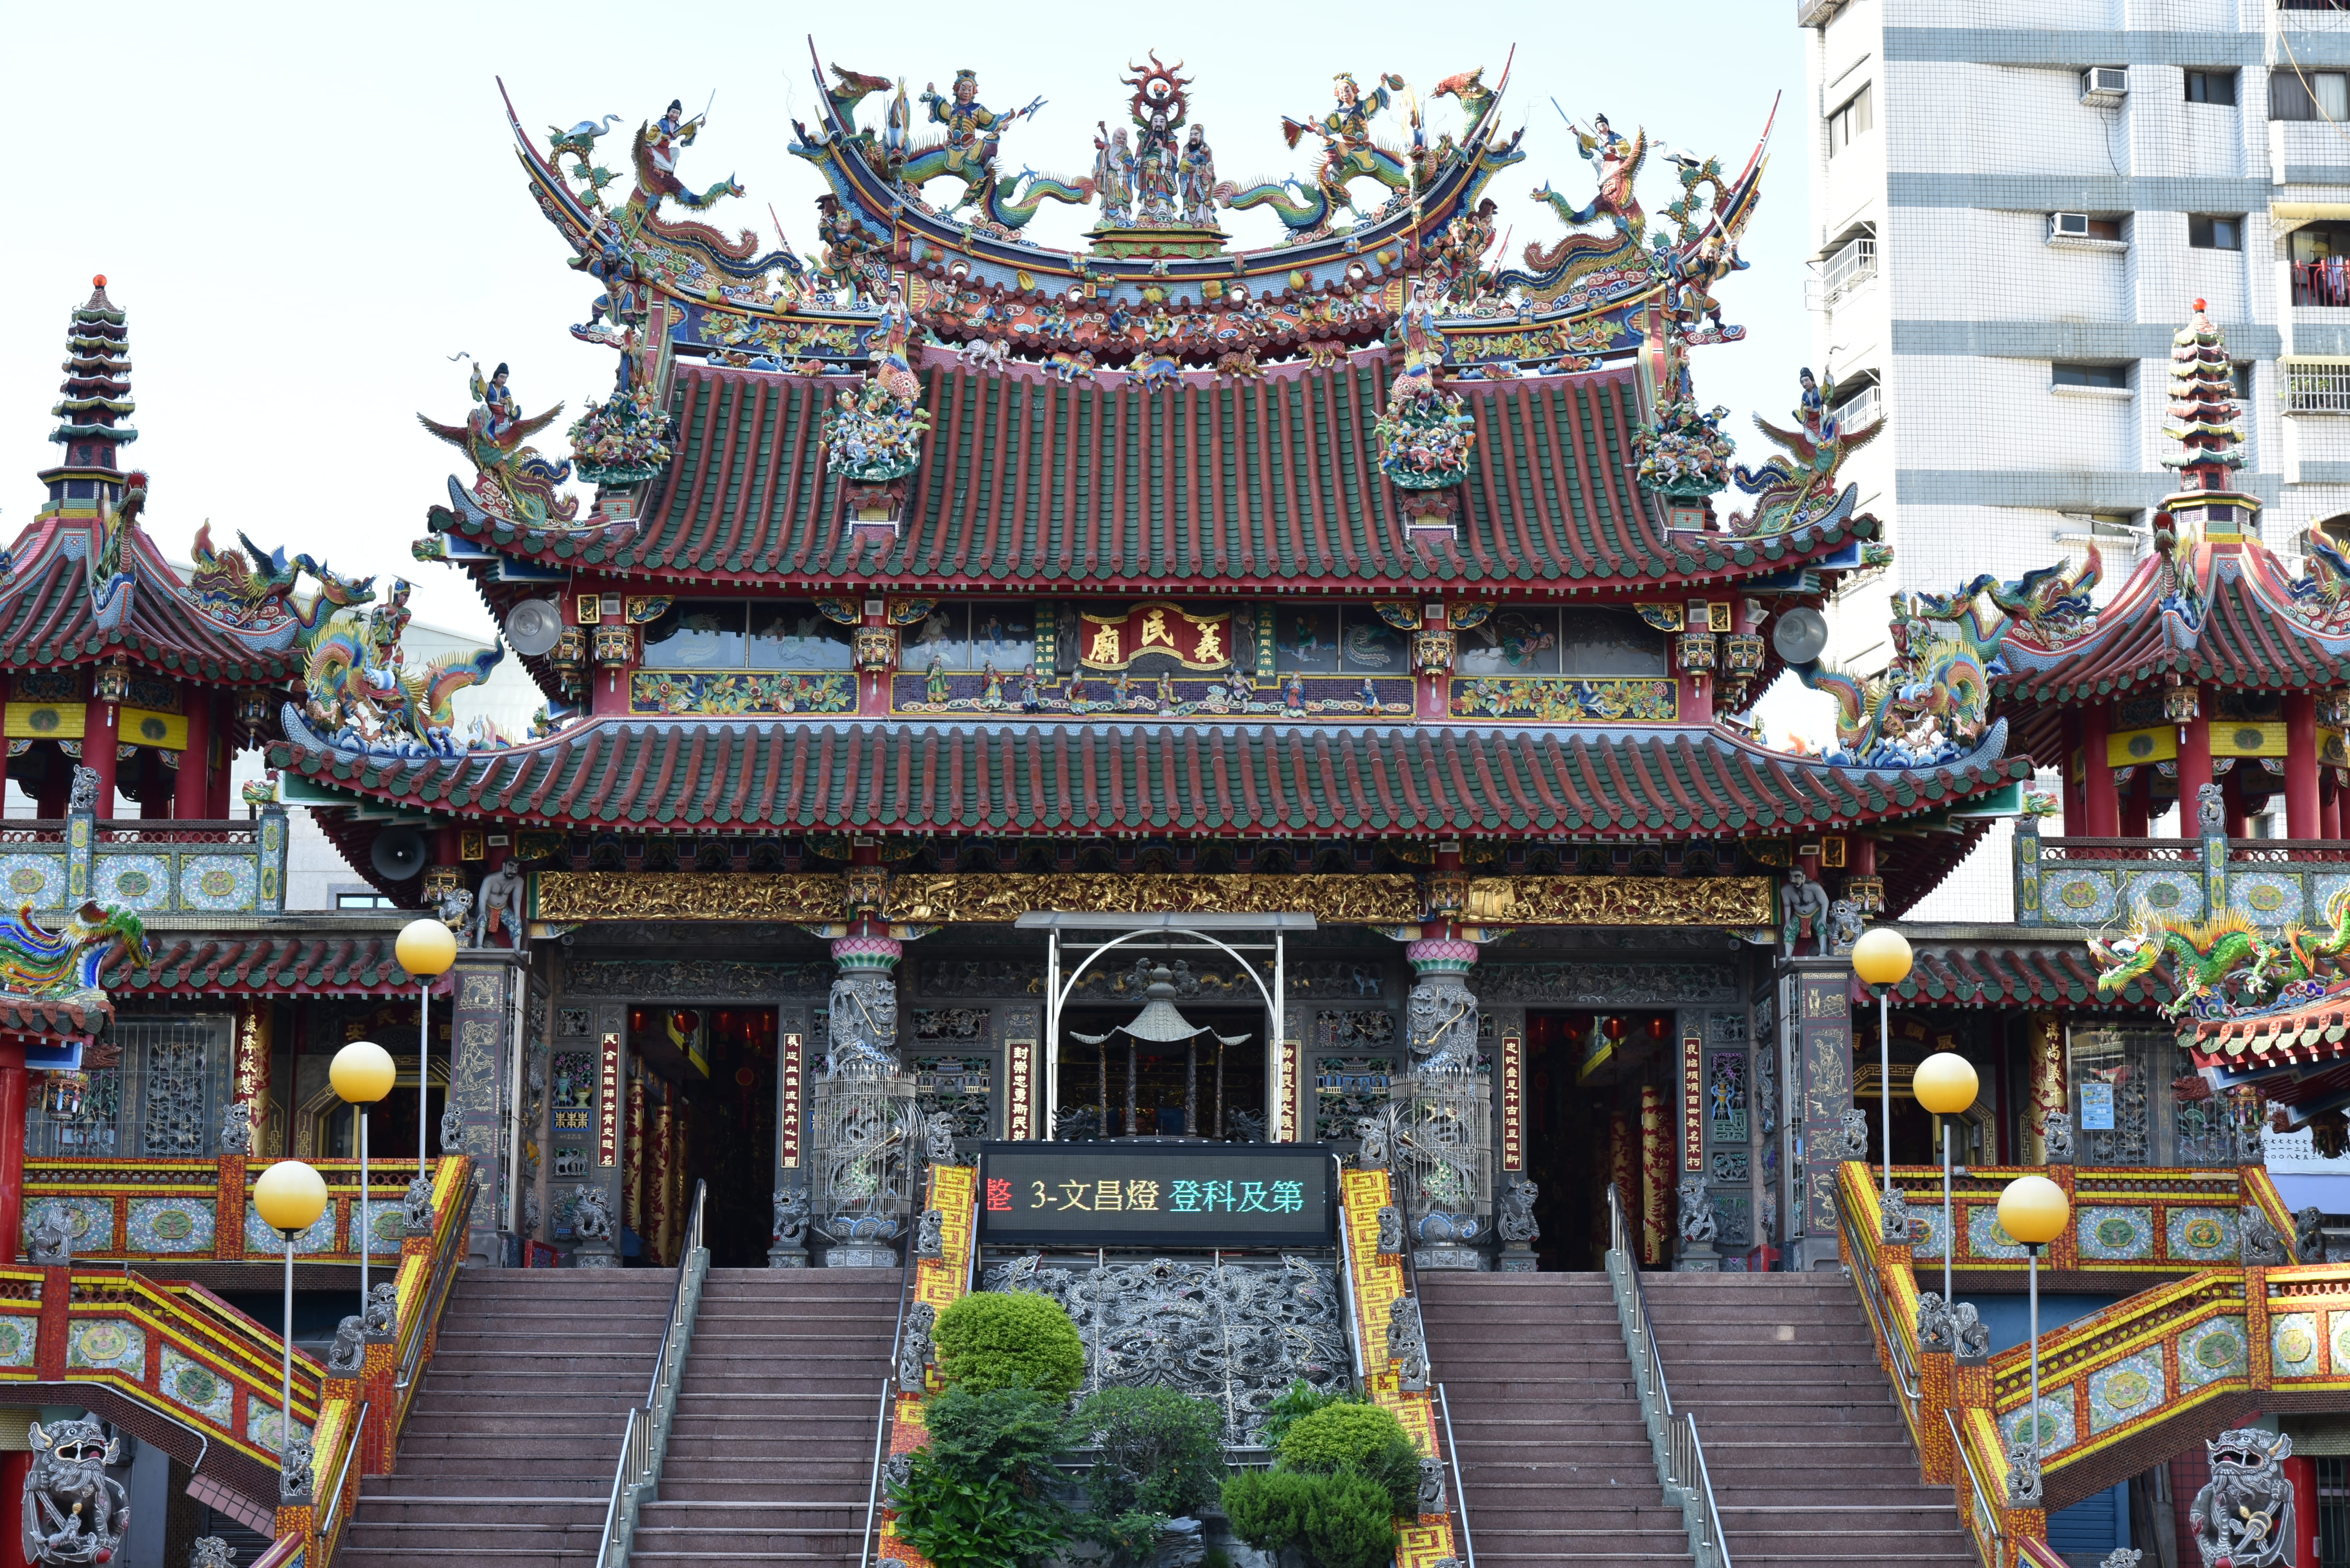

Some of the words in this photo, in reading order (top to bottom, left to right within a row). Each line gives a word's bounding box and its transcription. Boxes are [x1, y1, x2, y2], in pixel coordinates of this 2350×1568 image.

[1088, 607, 1225, 664] 義民廟
[987, 1178, 1012, 1210] 整
[1031, 1179, 1160, 1211] 3-文昌燈
[1168, 1180, 1305, 1213] 登科及第
